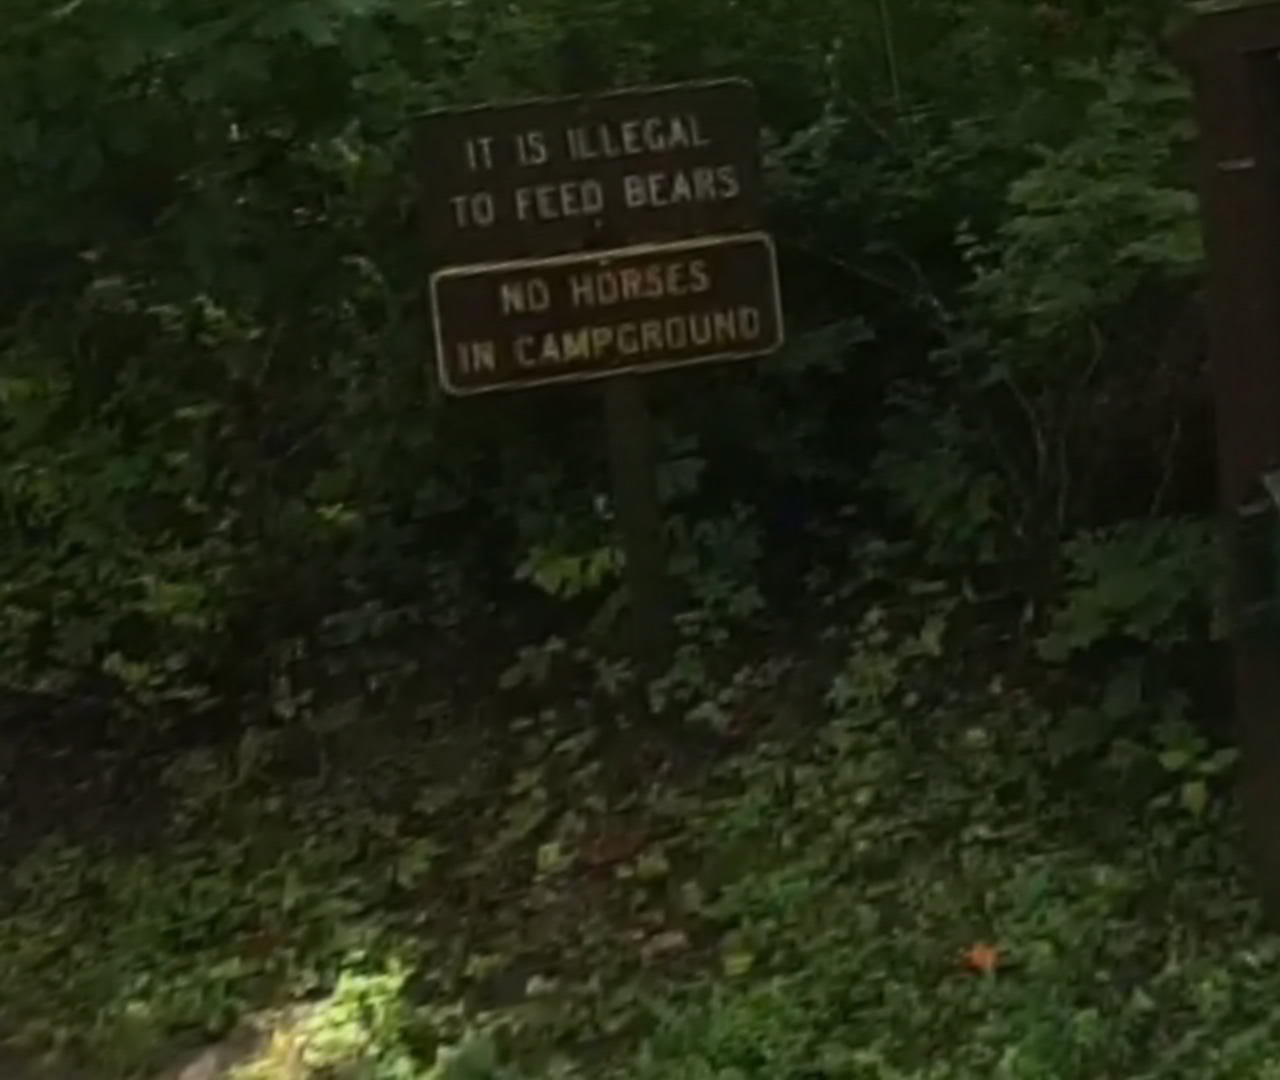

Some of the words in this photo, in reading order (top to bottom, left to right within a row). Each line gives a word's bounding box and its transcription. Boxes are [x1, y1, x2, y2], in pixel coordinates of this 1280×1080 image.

[465, 136, 495, 172] IT
[517, 130, 548, 167] IS
[566, 113, 711, 159] ILLEGAL
[450, 192, 495, 229] TO
[514, 180, 604, 222] FEED
[623, 165, 741, 209] BEARS
[500, 278, 550, 317] NO
[569, 259, 711, 309] HORSES
[456, 340, 495, 374] IN
[513, 306, 760, 367] CAMPGROUND
